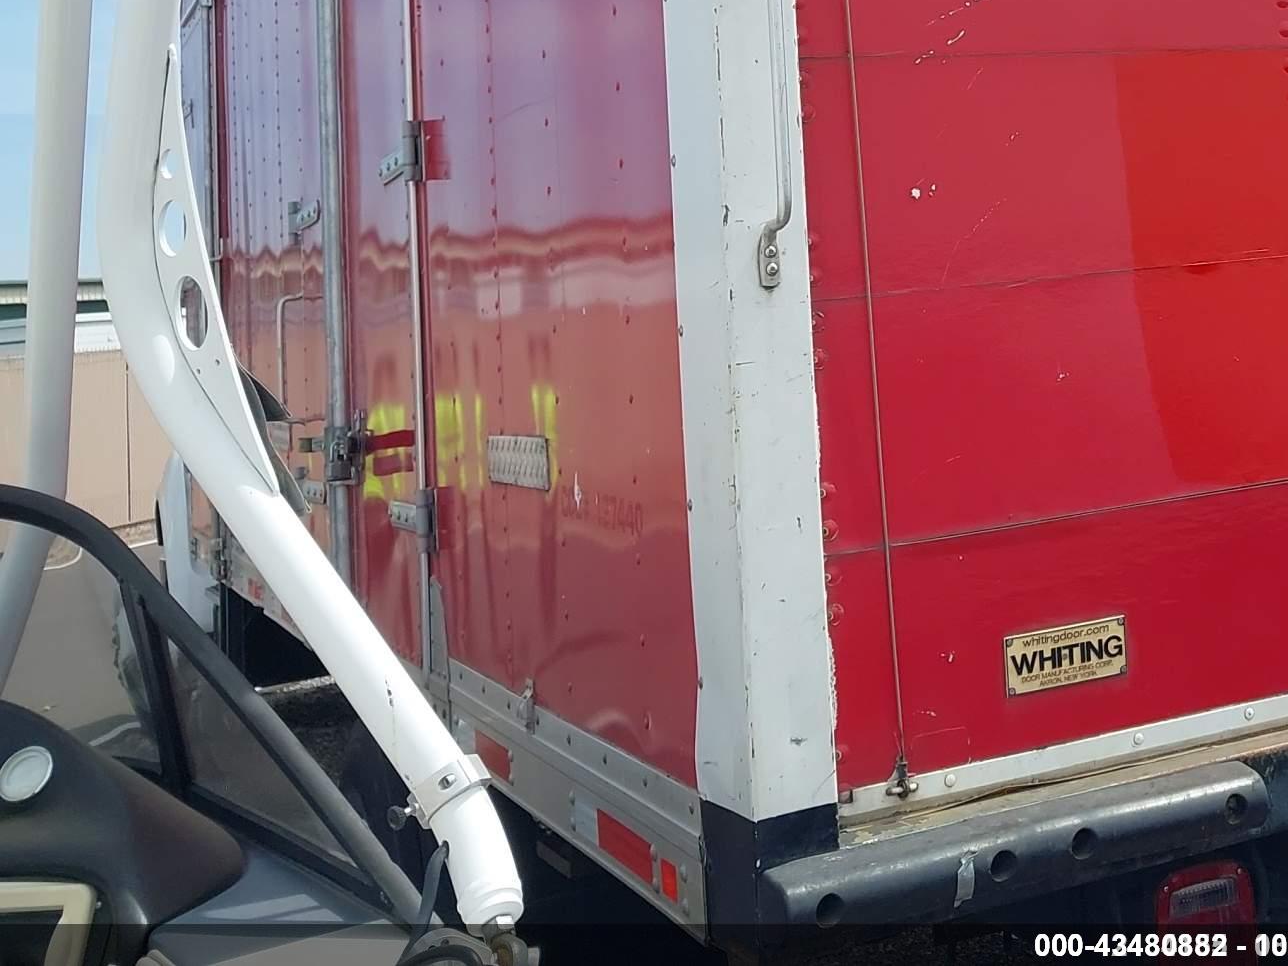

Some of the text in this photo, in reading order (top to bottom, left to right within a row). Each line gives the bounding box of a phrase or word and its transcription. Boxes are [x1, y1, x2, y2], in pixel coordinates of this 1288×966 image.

[1022, 624, 1110, 648] whitingdoor.com
[1010, 635, 1123, 677] WHITING
[1021, 675, 1041, 684] DOOR
[1041, 665, 1094, 680] MANUFACTURING
[1064, 674, 1078, 682] NEW
[1080, 670, 1097, 679] YORK
